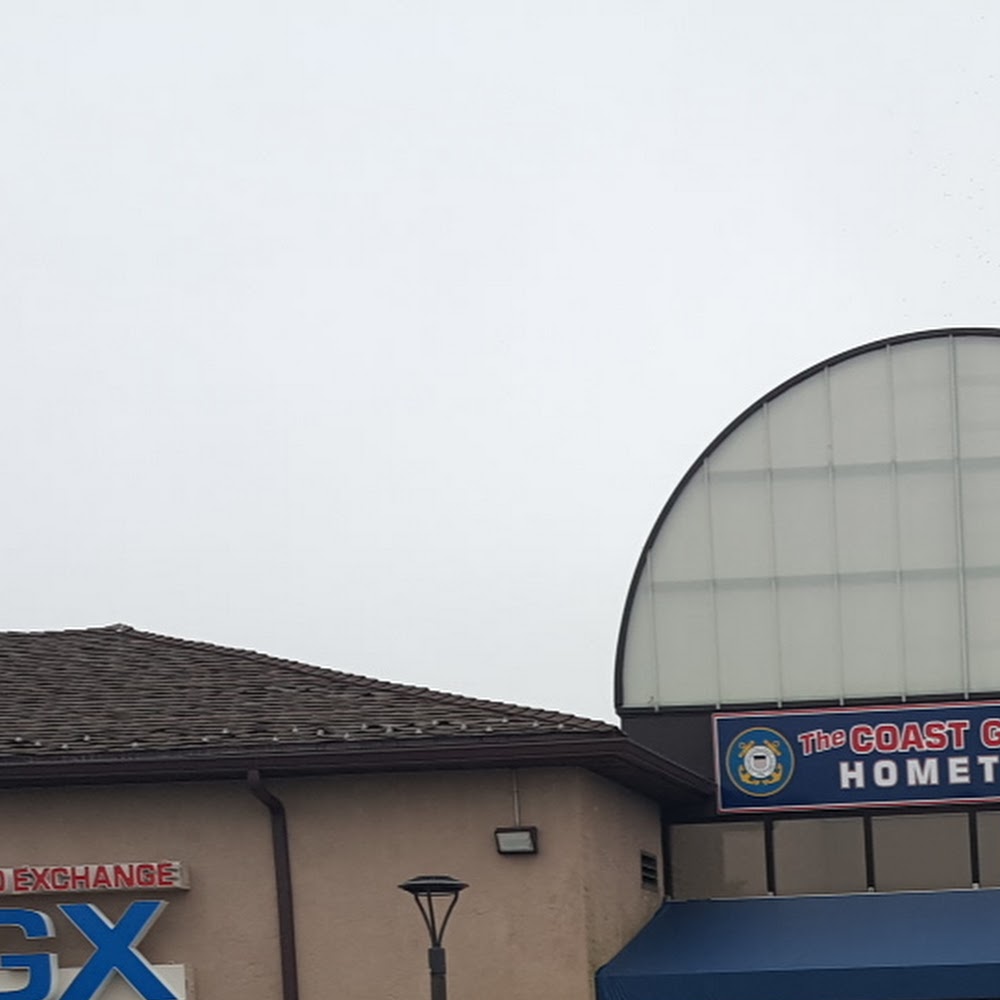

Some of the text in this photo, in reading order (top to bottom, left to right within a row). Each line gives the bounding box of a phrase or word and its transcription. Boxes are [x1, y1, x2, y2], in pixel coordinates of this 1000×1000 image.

[798, 729, 846, 756] The
[850, 720, 970, 755] COAST
[13, 863, 174, 892] EXCHANGE
